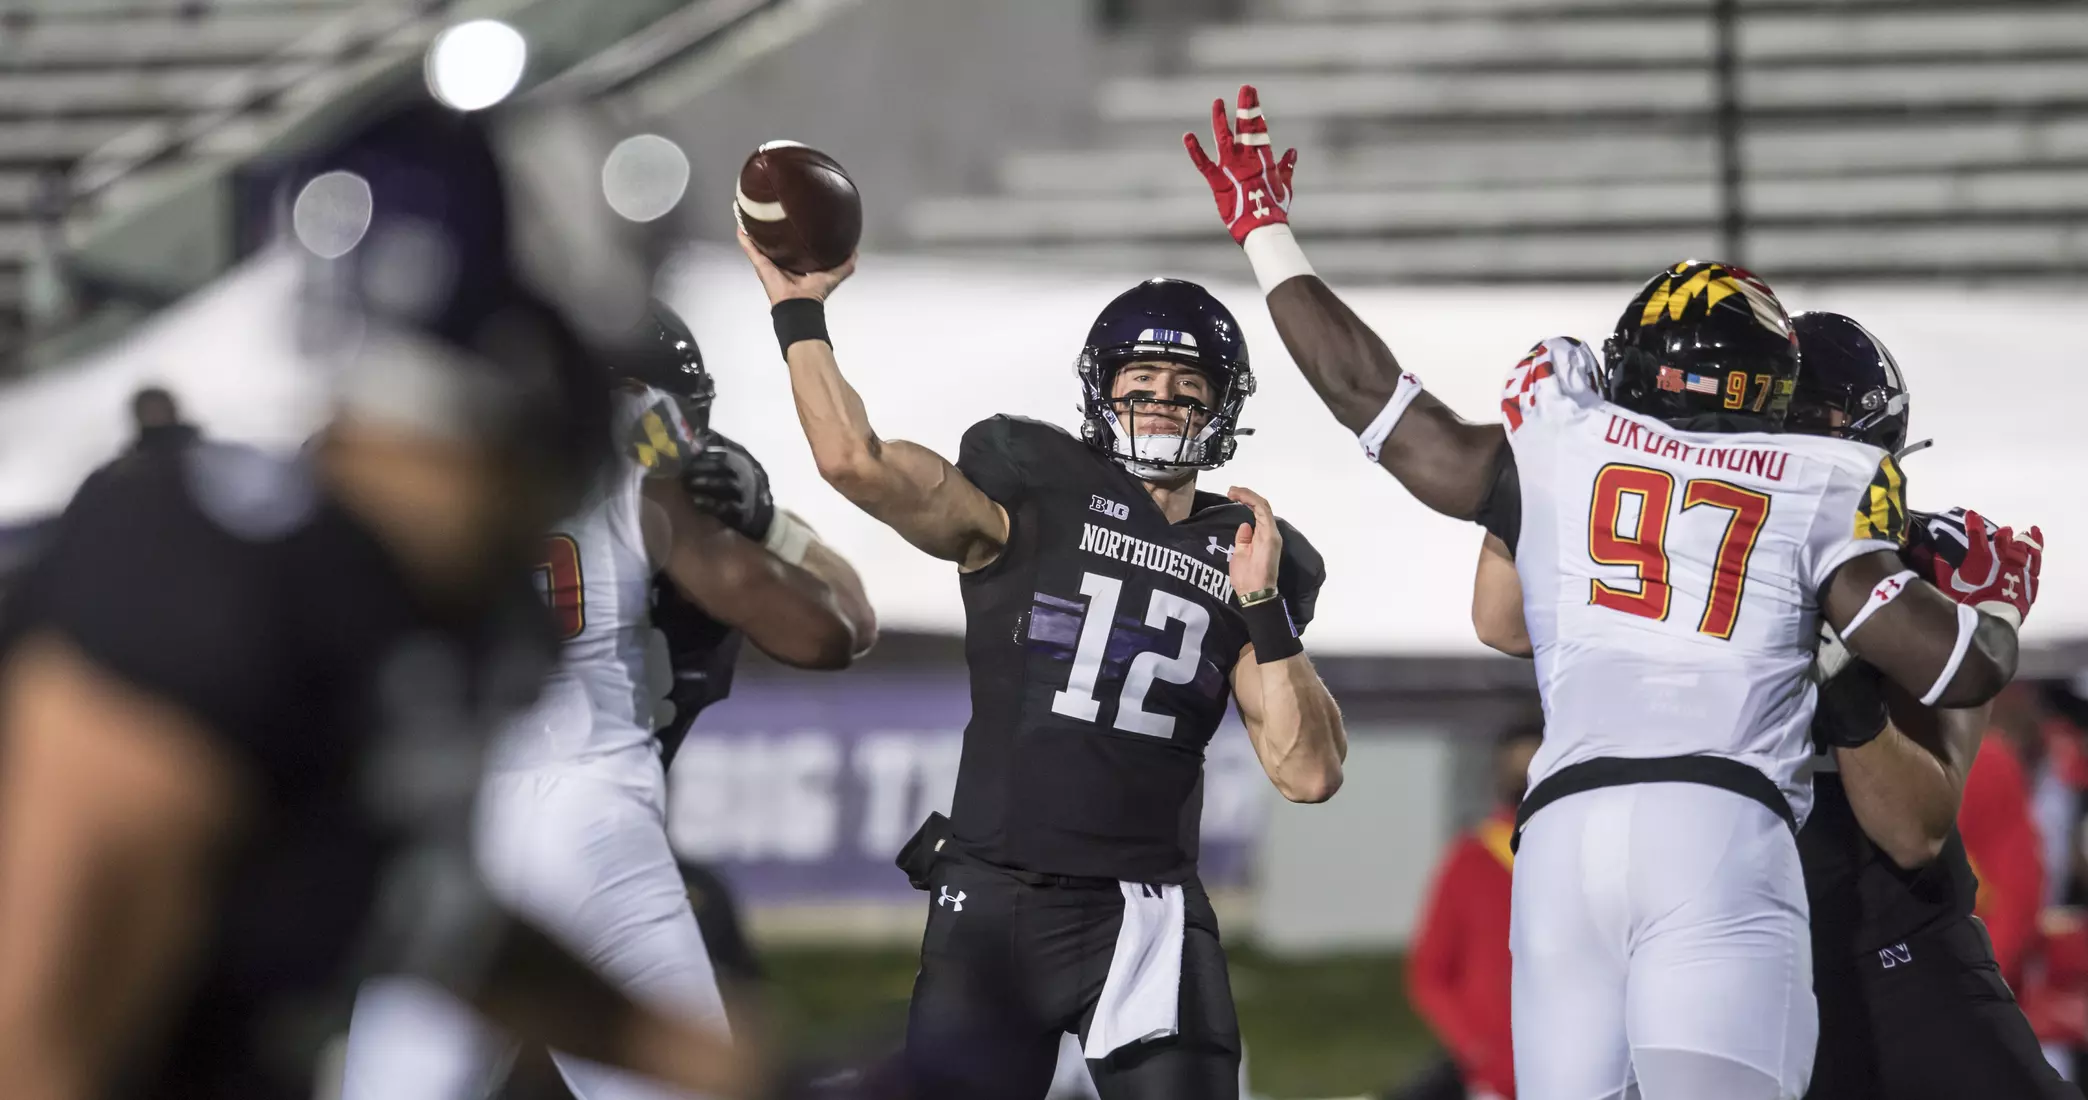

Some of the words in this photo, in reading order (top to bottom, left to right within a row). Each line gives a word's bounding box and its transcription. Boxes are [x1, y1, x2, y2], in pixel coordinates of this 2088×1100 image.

[1723, 370, 1772, 413] 97
[1078, 522, 1234, 605] NORTHWESTERN
[1587, 462, 1772, 641] 97
[1051, 571, 1211, 740] 12
[1878, 942, 1912, 968] N
